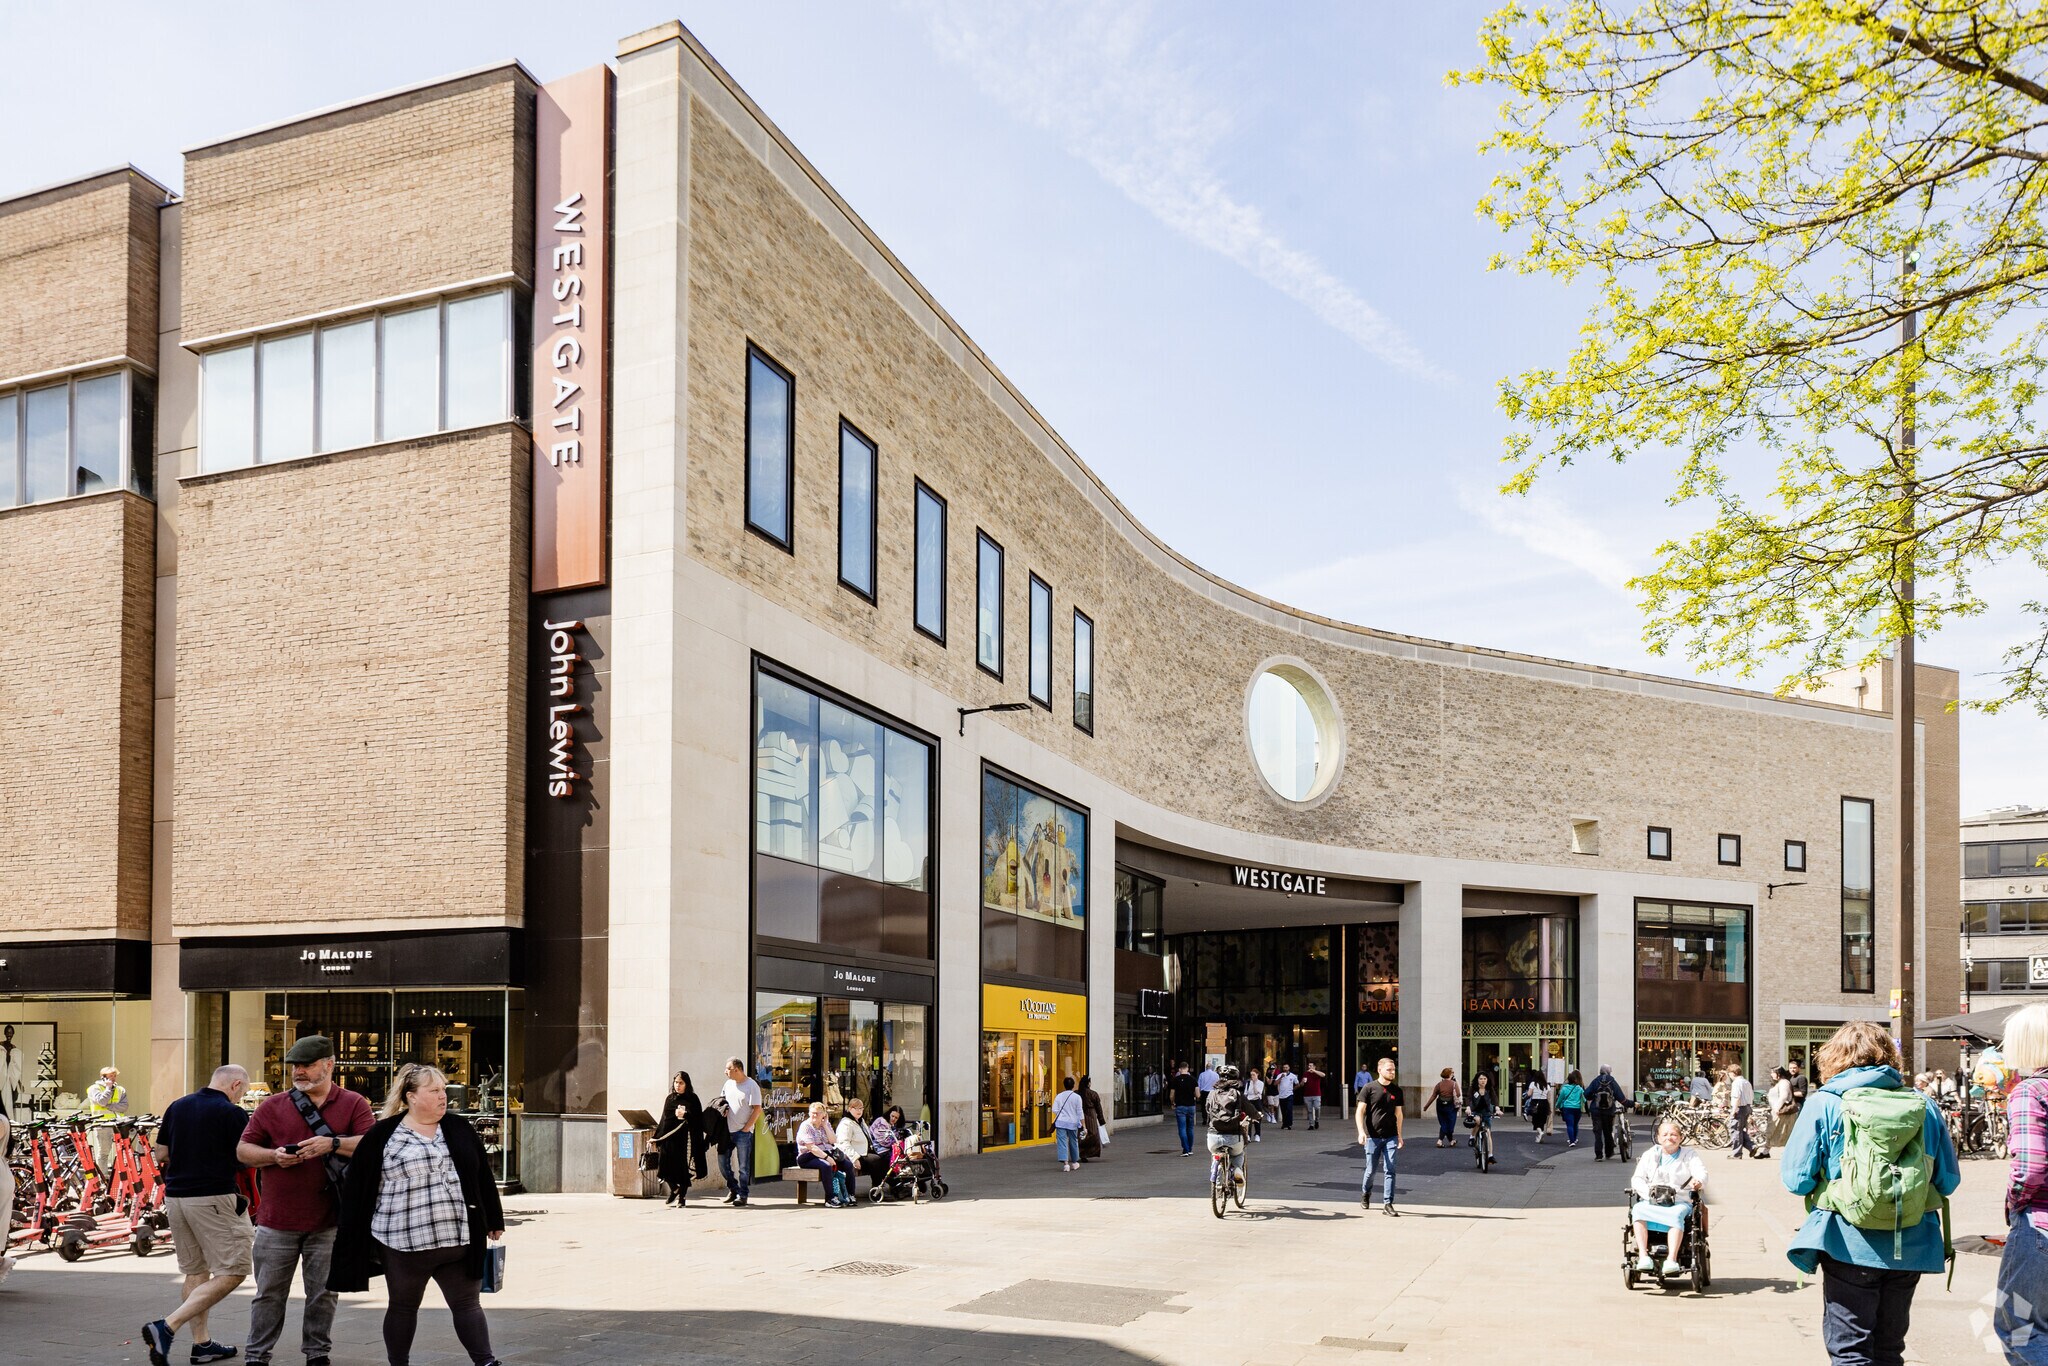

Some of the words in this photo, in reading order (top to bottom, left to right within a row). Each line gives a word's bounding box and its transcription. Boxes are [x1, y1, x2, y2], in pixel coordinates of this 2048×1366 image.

[551, 191, 584, 467] WESTGATE
[543, 619, 582, 697] John
[549, 703, 582, 797] Lewis
[1235, 865, 1326, 895] WESTGATE
[1463, 997, 1535, 1011] IBANAIS
[1640, 1040, 1693, 1050] COMPTOIR
[1697, 1041, 1741, 1051] LIBANAIS
